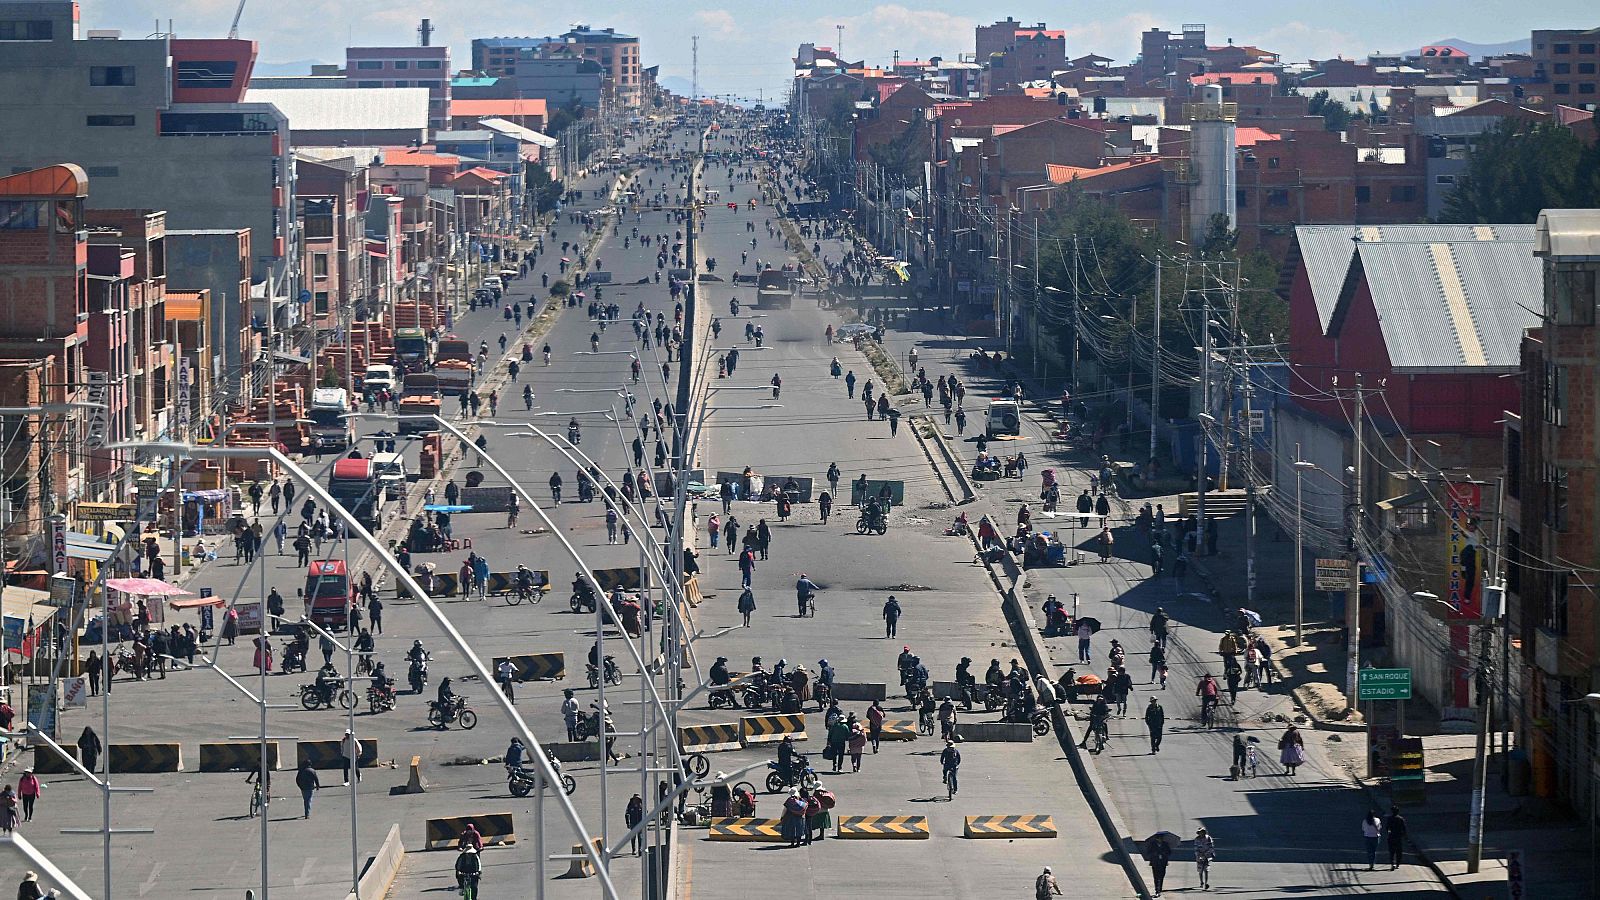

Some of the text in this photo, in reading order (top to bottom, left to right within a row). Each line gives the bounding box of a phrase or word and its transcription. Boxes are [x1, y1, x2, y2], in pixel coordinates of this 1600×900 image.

[179, 358, 189, 424] FARMACIA
[54, 526, 65, 573] FARMACI
[1450, 502, 1459, 612] JACKIE CHAN
[65, 677, 85, 702] BAÑO
